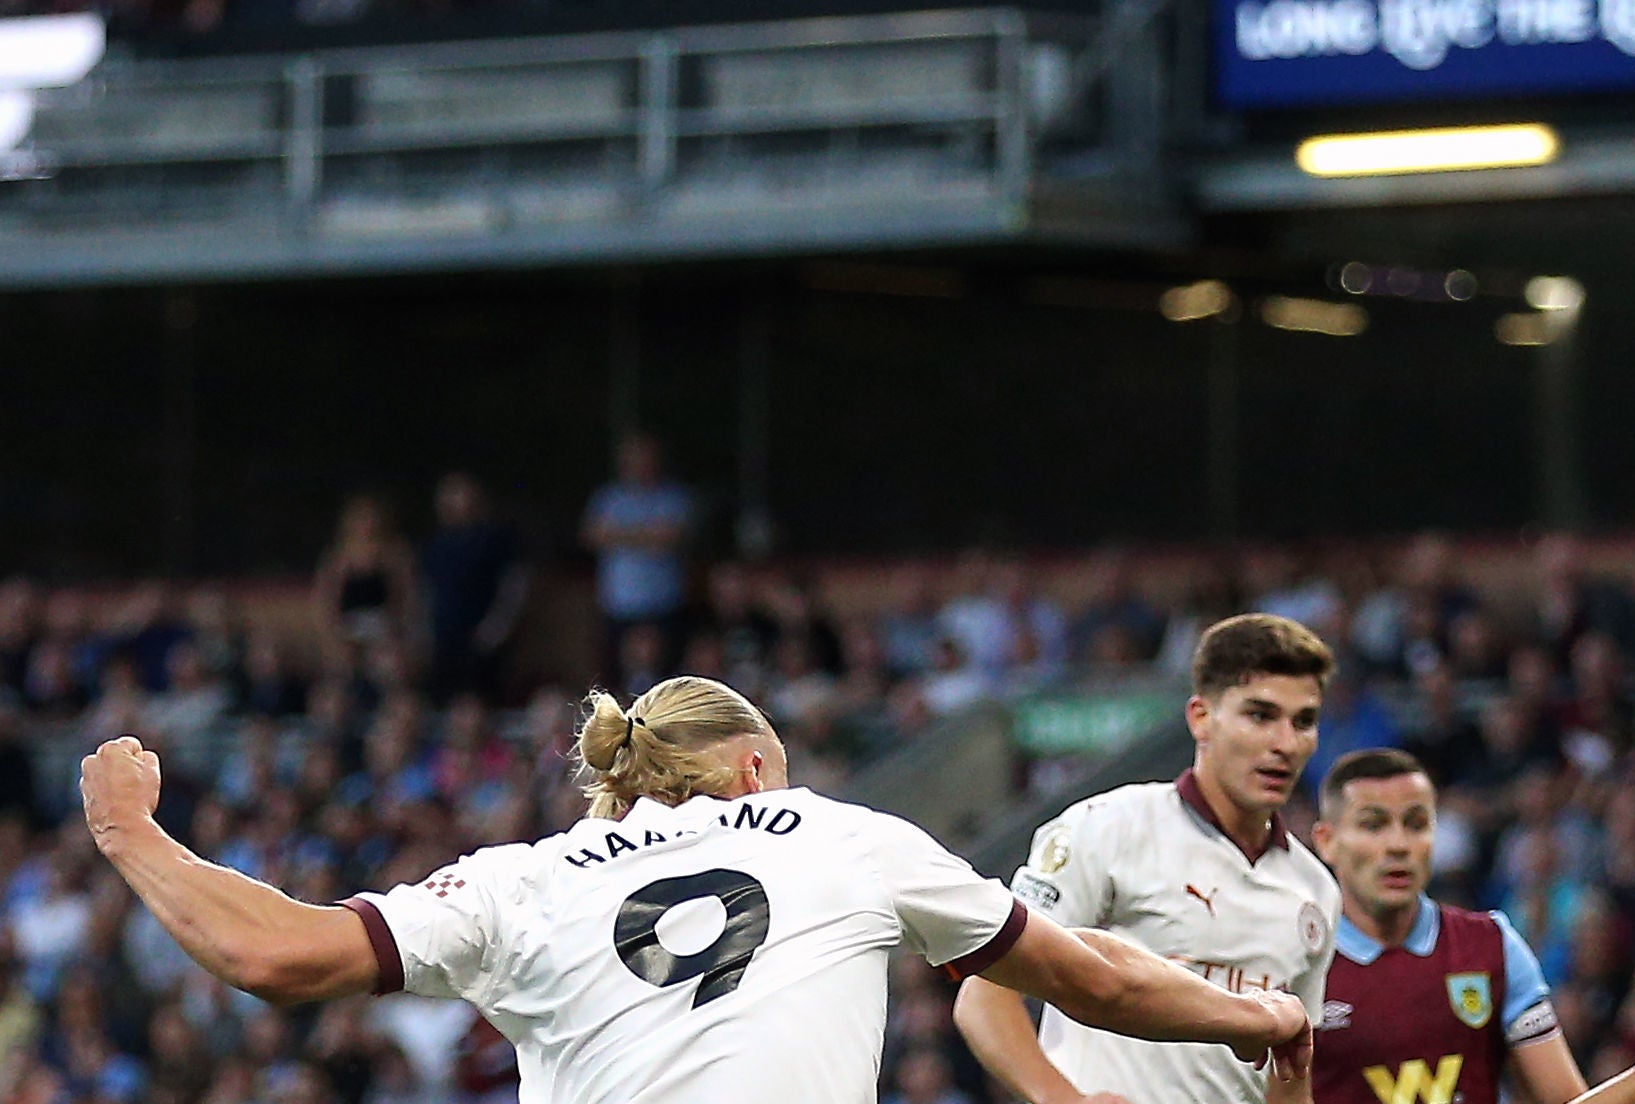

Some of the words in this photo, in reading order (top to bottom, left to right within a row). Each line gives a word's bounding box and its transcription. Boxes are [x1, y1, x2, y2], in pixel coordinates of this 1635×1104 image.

[1235, 1, 1377, 61] LONG
[565, 803, 802, 868] HAAND
[613, 868, 770, 1010] 9
